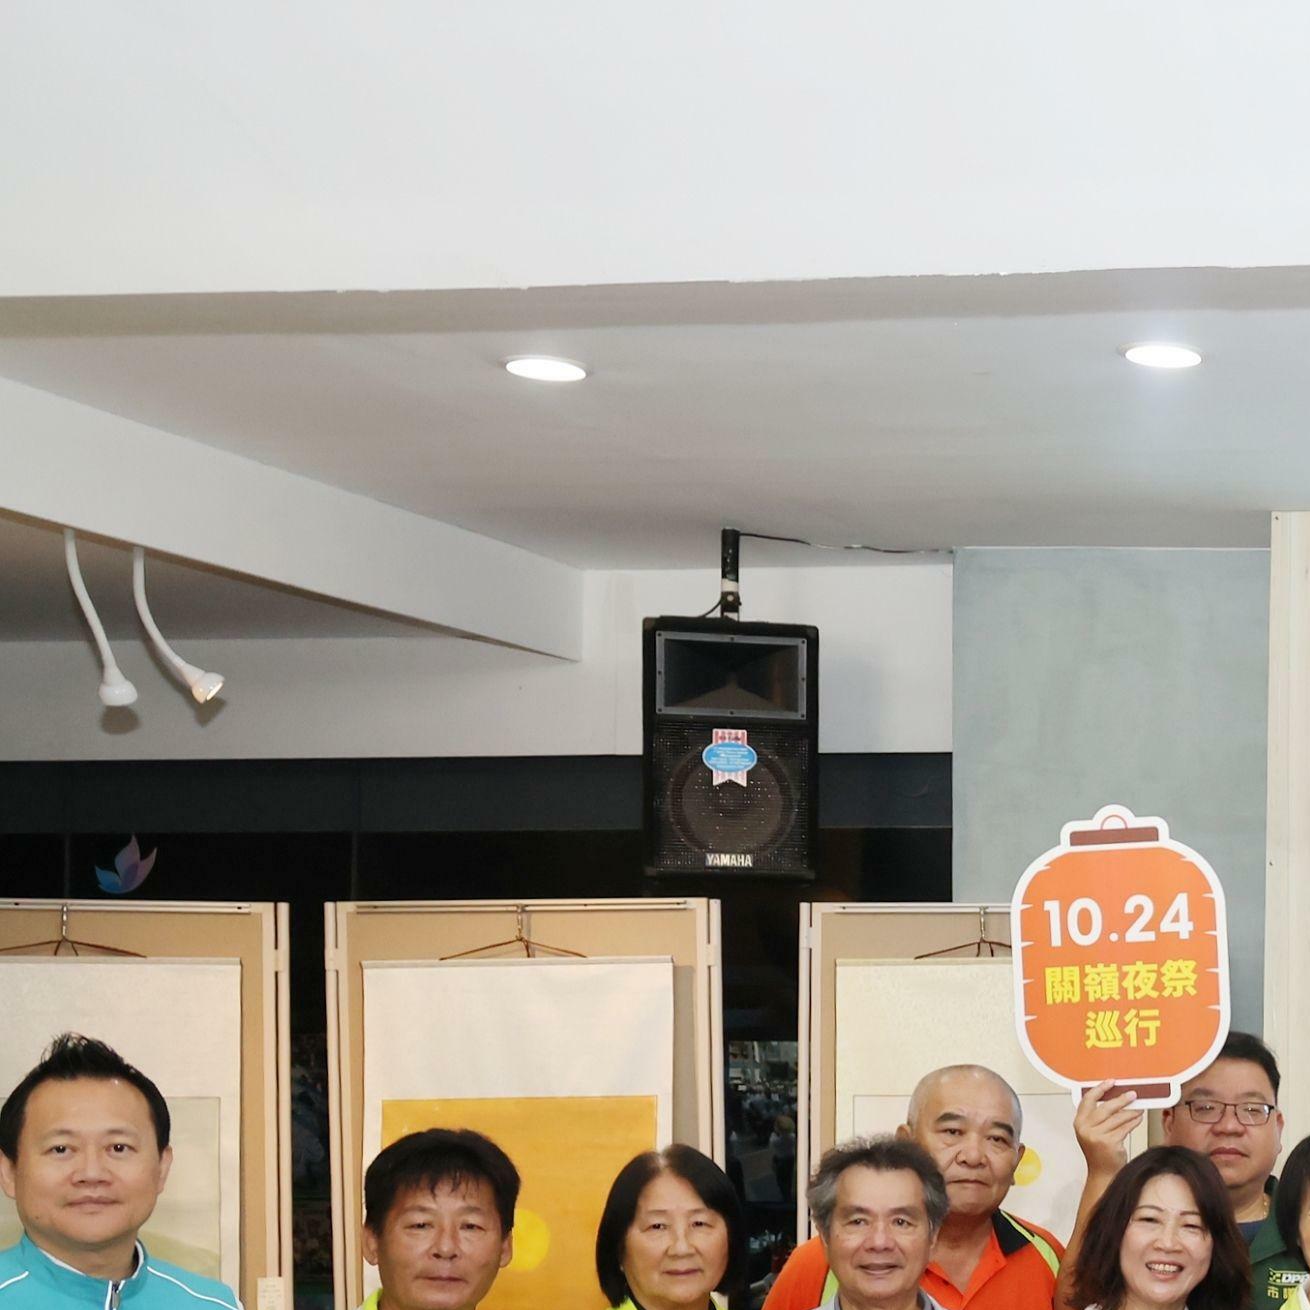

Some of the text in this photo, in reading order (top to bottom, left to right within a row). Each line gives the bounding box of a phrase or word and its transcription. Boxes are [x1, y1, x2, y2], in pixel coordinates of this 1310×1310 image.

[706, 853, 752, 867] YAMAHA
[1043, 893, 1194, 948] 10.24
[1044, 959, 1198, 1005] 關嶺夜祭
[1085, 1009, 1161, 1049] 巡行
